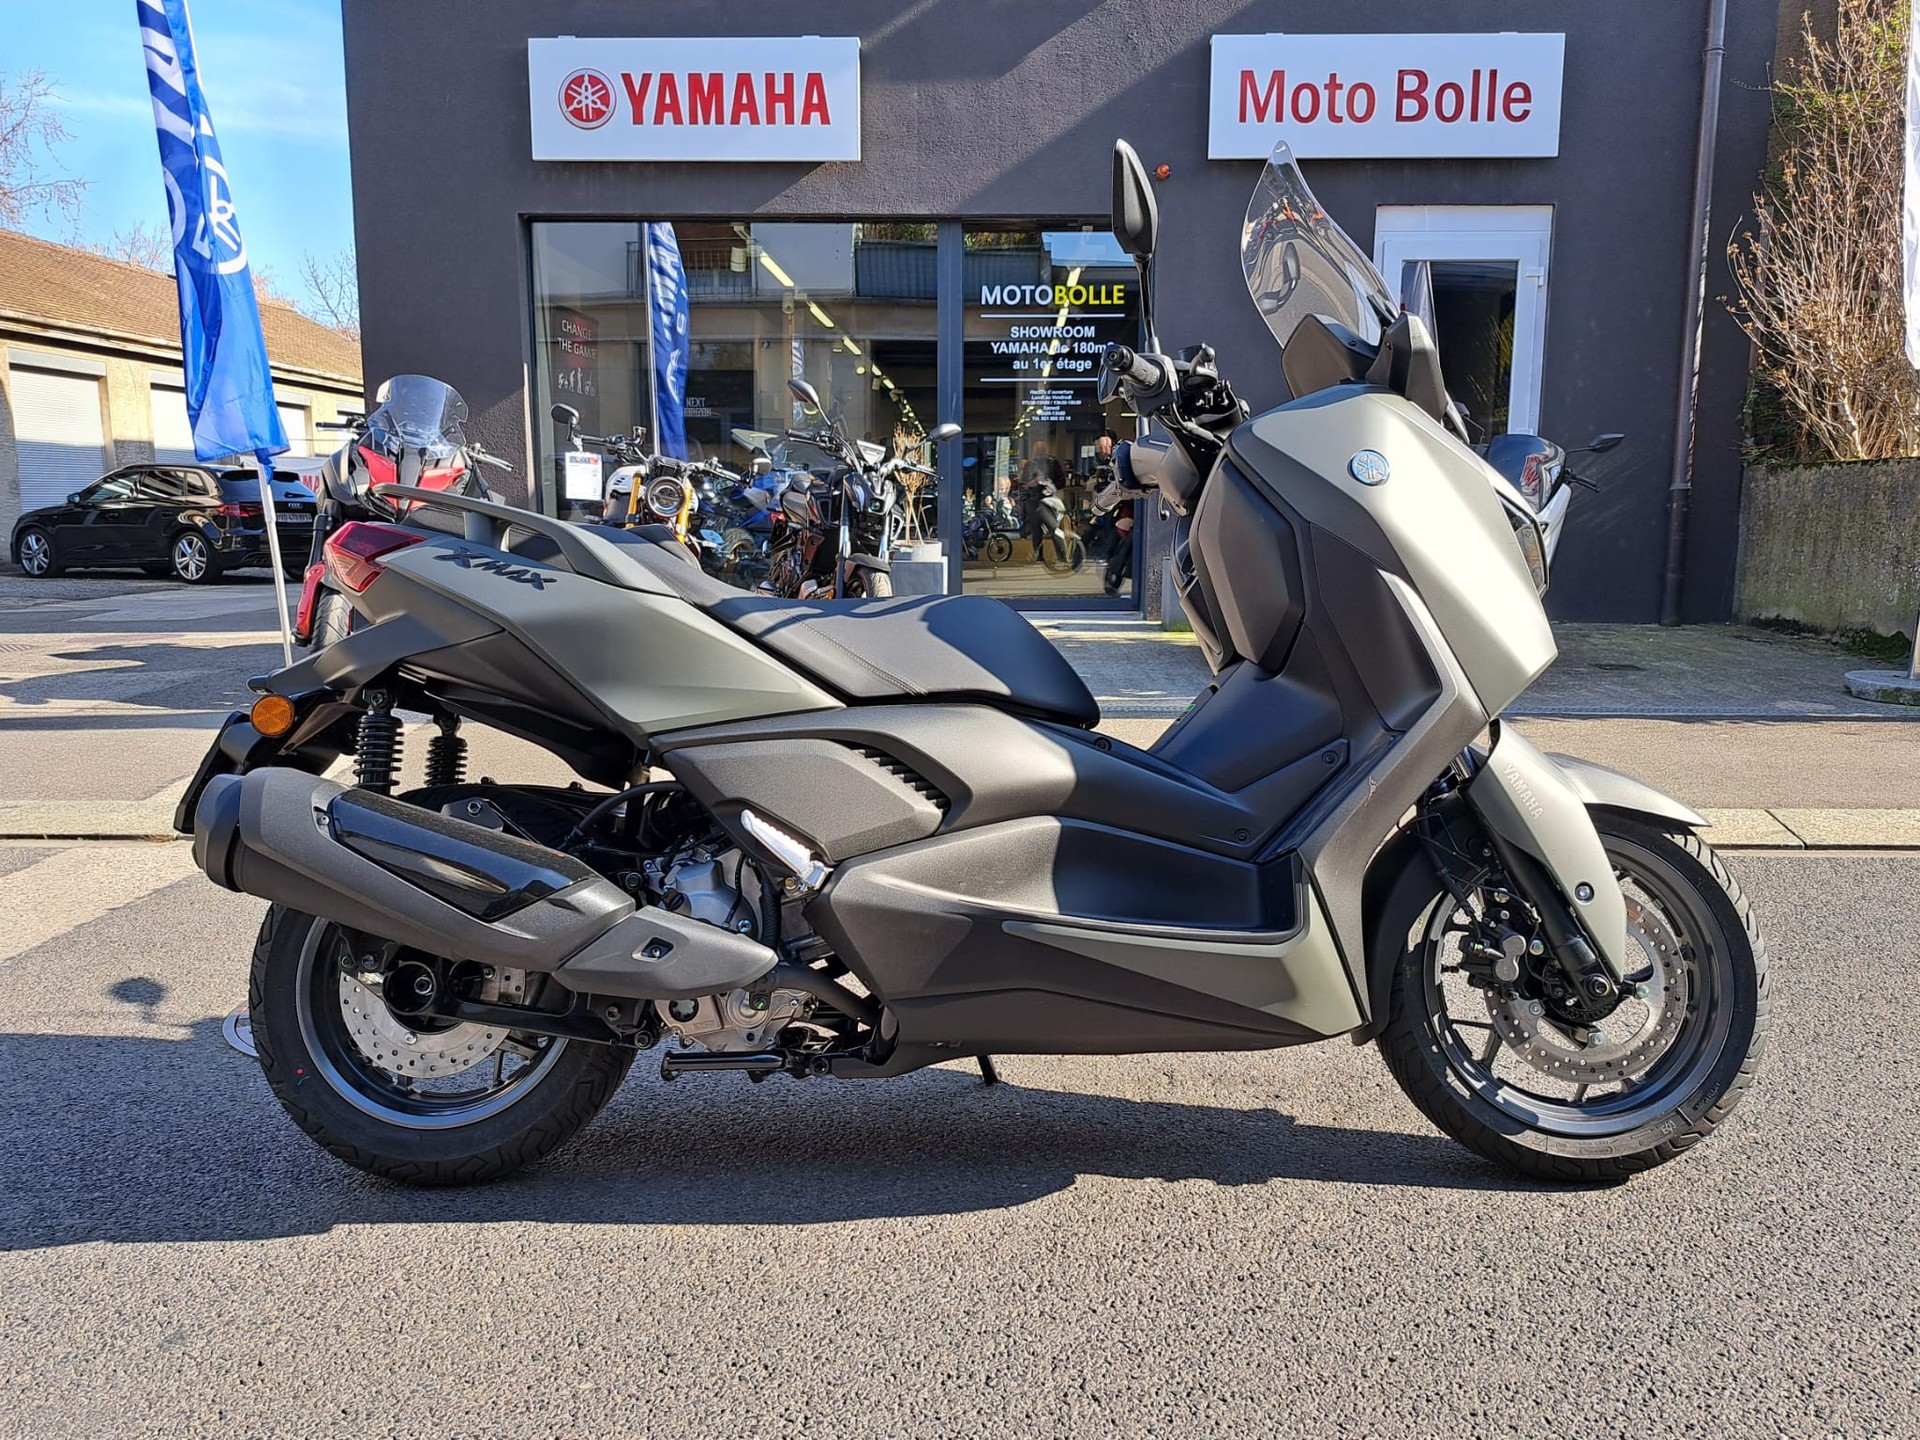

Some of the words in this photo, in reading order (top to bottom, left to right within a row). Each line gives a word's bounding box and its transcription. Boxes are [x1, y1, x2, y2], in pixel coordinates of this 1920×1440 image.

[620, 72, 832, 126] YAMAHA
[1238, 69, 1376, 124] Moto
[1395, 69, 1532, 123] Bolle
[981, 285, 1125, 305] MOTOBOLLE
[562, 319, 593, 340] CHANGE
[1010, 326, 1095, 338] SHOWROOM
[557, 337, 572, 353] THE
[573, 342, 597, 360] GAME
[991, 342, 1049, 353] YAMAHA
[1073, 341, 1115, 353] 180m
[1013, 360, 1028, 369] au
[1033, 358, 1053, 369] 1er
[1056, 357, 1092, 372] étage
[686, 397, 706, 407] NEXT
[1503, 762, 1544, 820] YAMAHA
